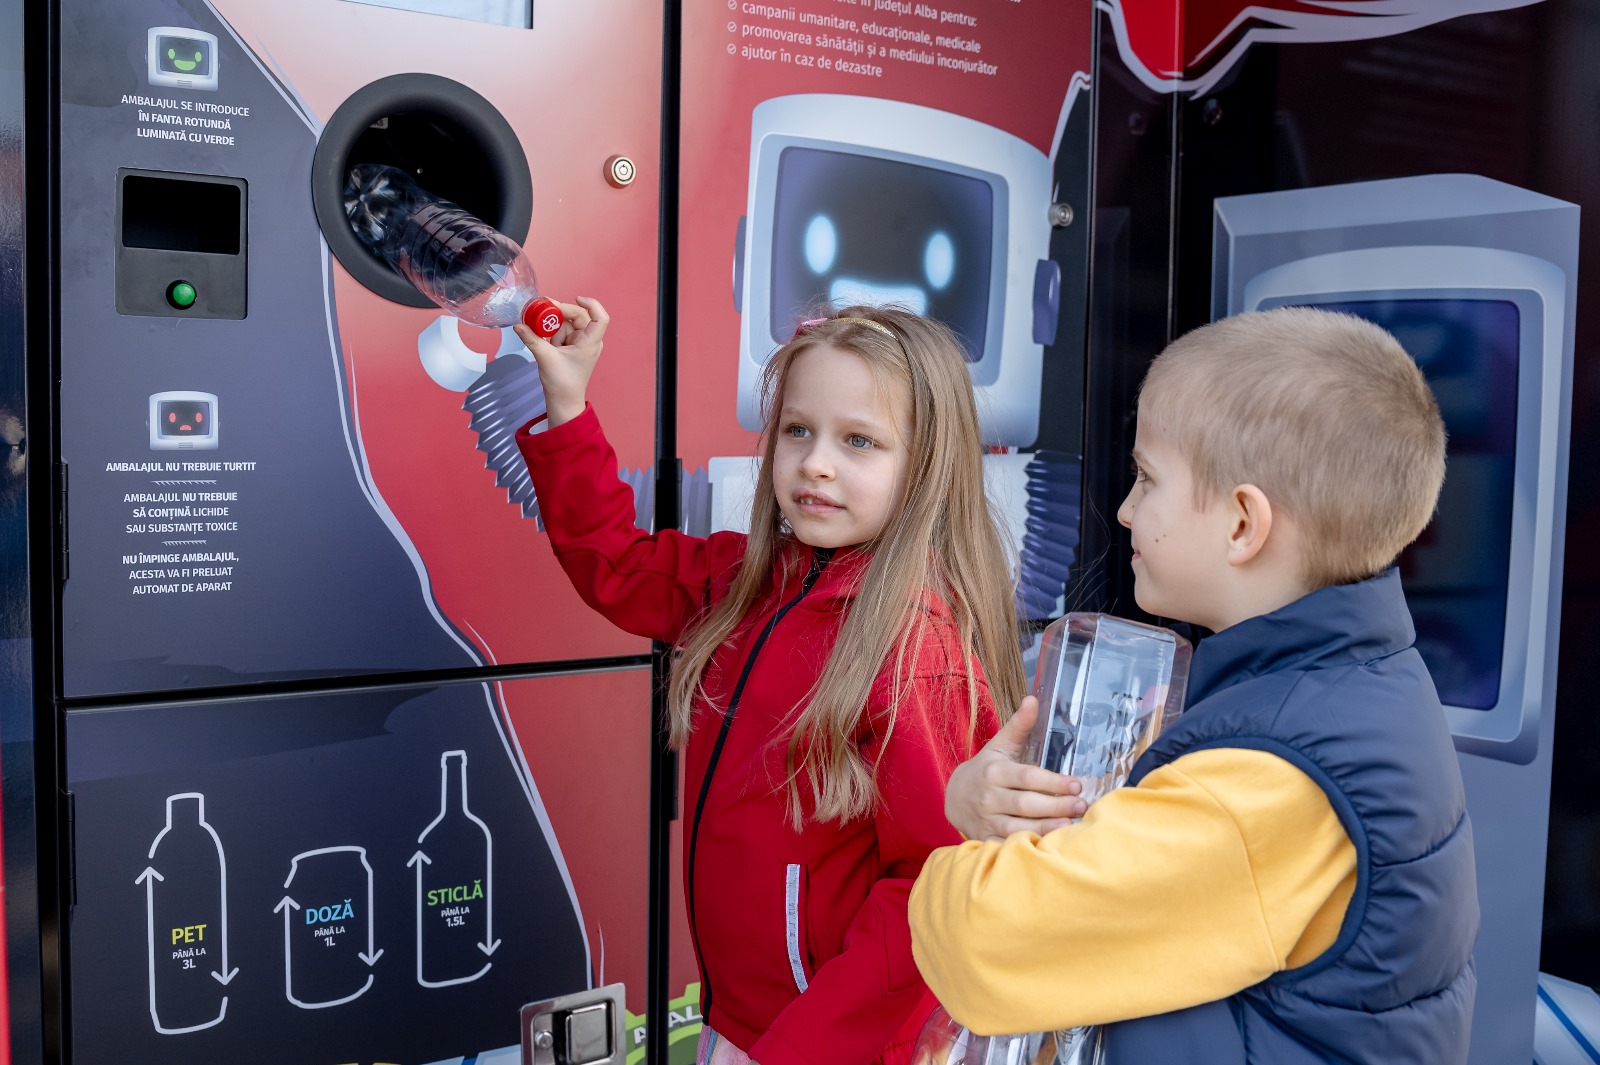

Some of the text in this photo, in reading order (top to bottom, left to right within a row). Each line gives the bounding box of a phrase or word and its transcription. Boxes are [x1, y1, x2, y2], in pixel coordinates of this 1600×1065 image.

[914, 4, 937, 19] Alba
[941, 11, 977, 27] pentru:
[742, 2, 981, 53] campanii umanitare, educaționale, medicale
[742, 24, 812, 45] promovarea
[816, 34, 864, 56] sănătății
[879, 46, 886, 57] a
[890, 47, 934, 64] mediului
[742, 44, 882, 77] ajutor în caz de dezastre
[121, 95, 249, 116] AMBALAJUL SE INTRODUCE
[138, 109, 231, 130] ÎN FANTA ROTUNDĂ
[137, 128, 234, 145] LUMINATĂ CU VERDE
[106, 462, 256, 472] AMBALAJUL NU TREBUIE TURTIT
[123, 492, 238, 503] AMBALAJUL NU TREBUIE
[133, 506, 229, 520] SĂ CONȚINĂ LICHIDE
[126, 522, 238, 535] SAU SUBSTANȚE TOXICE
[123, 552, 239, 564] NU ÎMPINGE AMBALAJUL,
[129, 567, 233, 579] ACESTA VA FI PRELUAT
[133, 582, 232, 594] AUTOMAT DE APARAT
[427, 879, 484, 906] STICLĂ
[306, 898, 354, 925] DOZĂ
[461, 906, 470, 914] LA
[446, 916, 465, 927] 1.5L
[172, 924, 207, 944] PET
[314, 926, 345, 937] PÂNĂ LA
[324, 937, 335, 946] 1L
[172, 948, 206, 959] PÂNĂ LA
[182, 959, 196, 969] 3L
